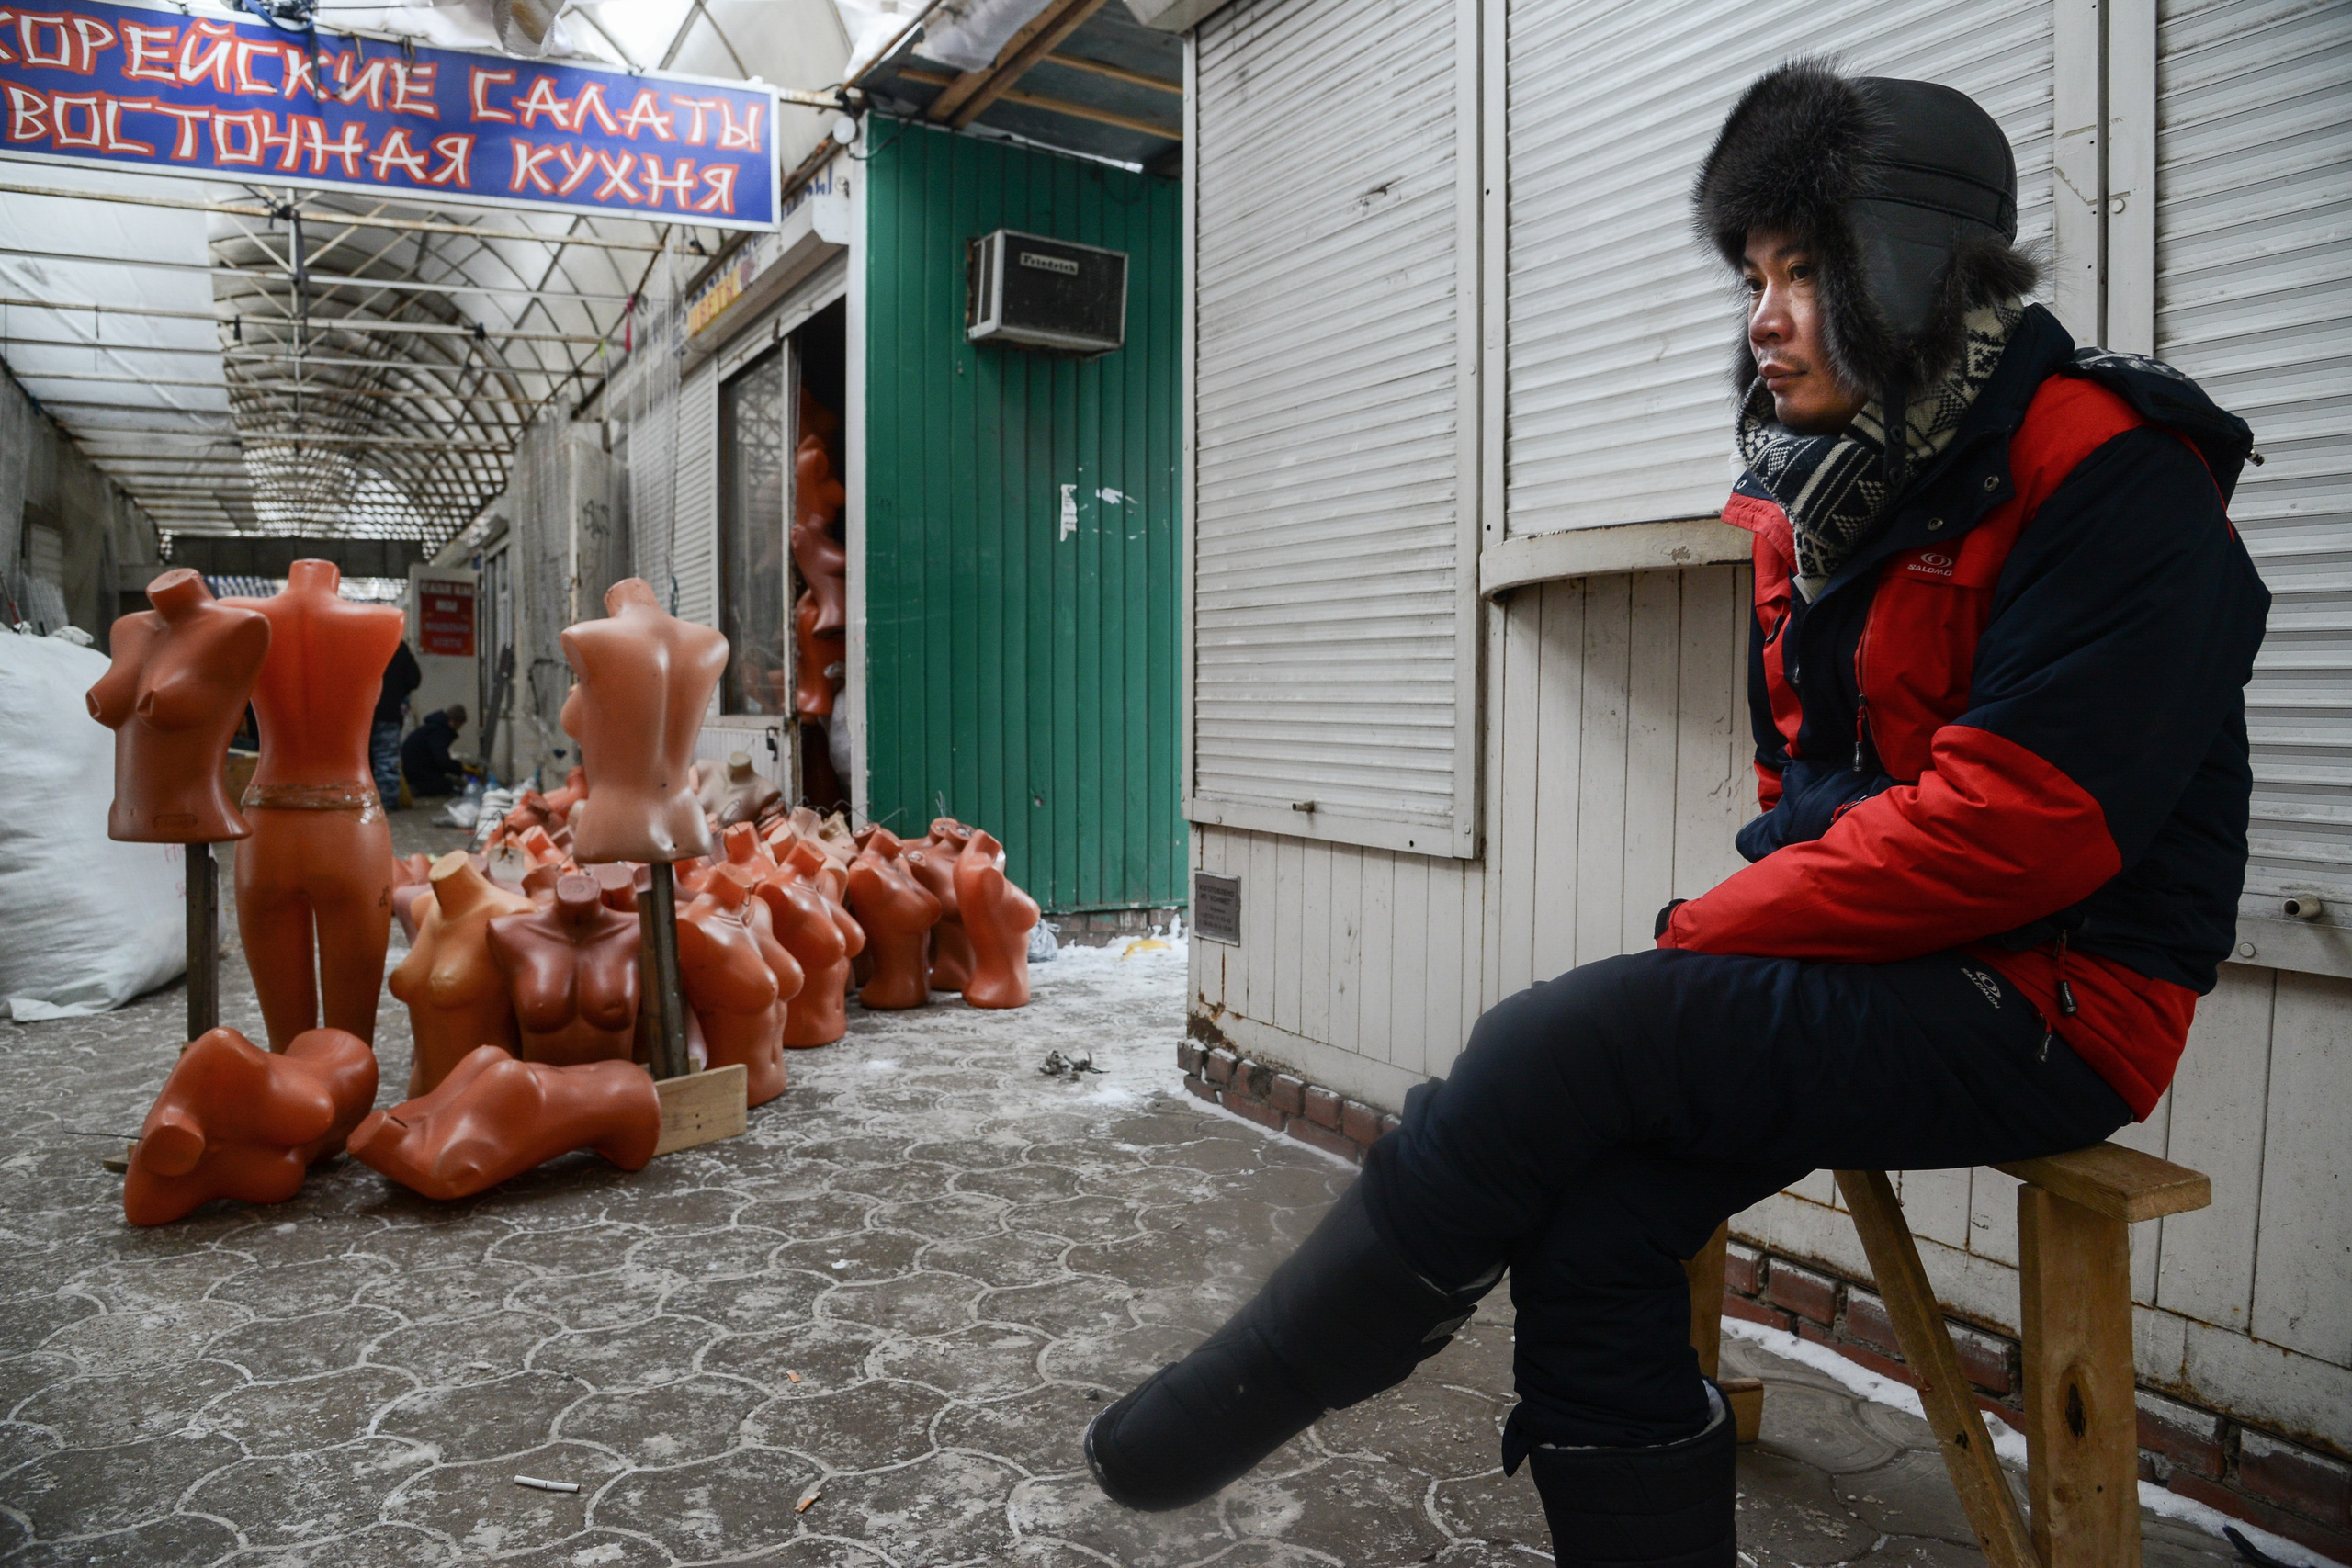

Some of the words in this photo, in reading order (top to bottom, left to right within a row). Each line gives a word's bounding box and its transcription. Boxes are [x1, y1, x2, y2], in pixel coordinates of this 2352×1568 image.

[469, 65, 764, 152] САЛАТЫ
[4, 81, 474, 187] ВОСТОЧНАЯ
[509, 138, 739, 214] КУХНЯ
[1023, 254, 1076, 273] Friedrich
[1907, 563, 1952, 577] SALOMO
[1960, 967, 2001, 1009] SALOMON
